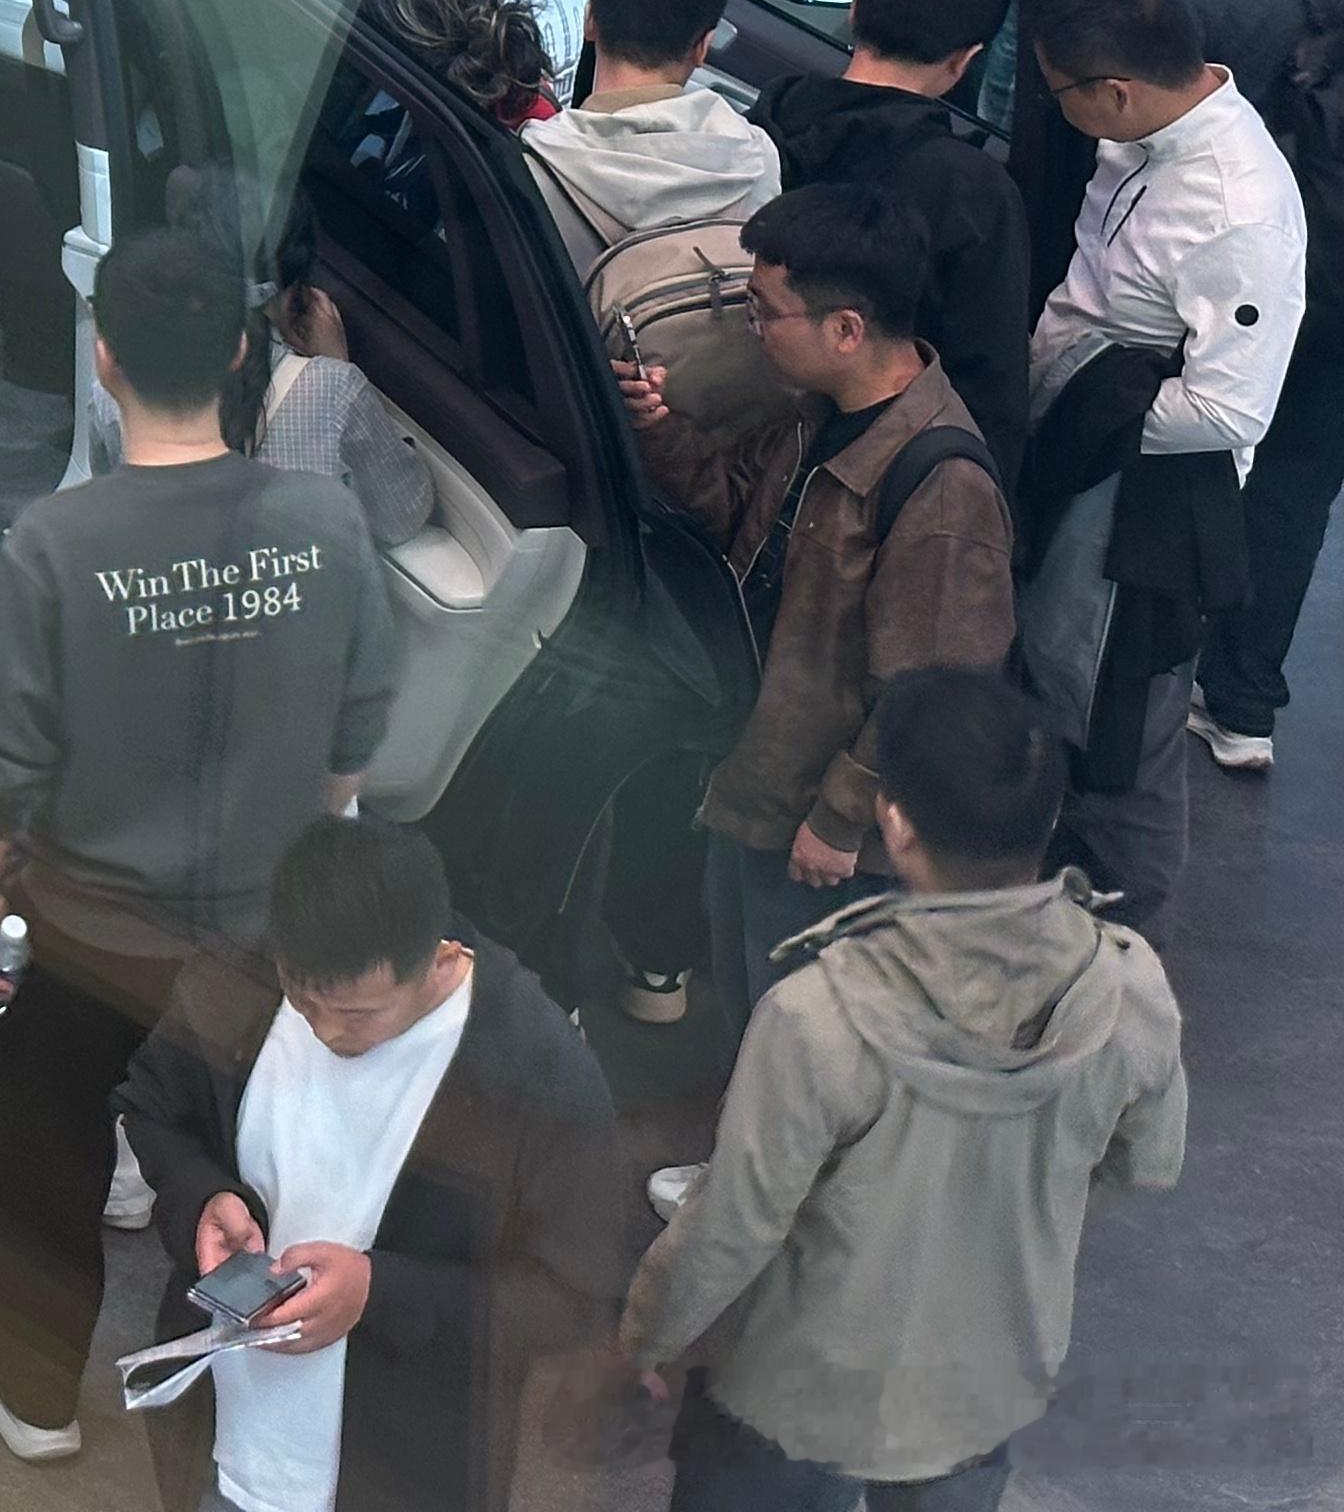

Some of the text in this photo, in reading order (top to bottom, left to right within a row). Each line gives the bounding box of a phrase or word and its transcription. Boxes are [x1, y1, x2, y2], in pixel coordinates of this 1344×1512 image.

[95, 543, 322, 603] Win The First
[127, 582, 301, 636] Place 1984
